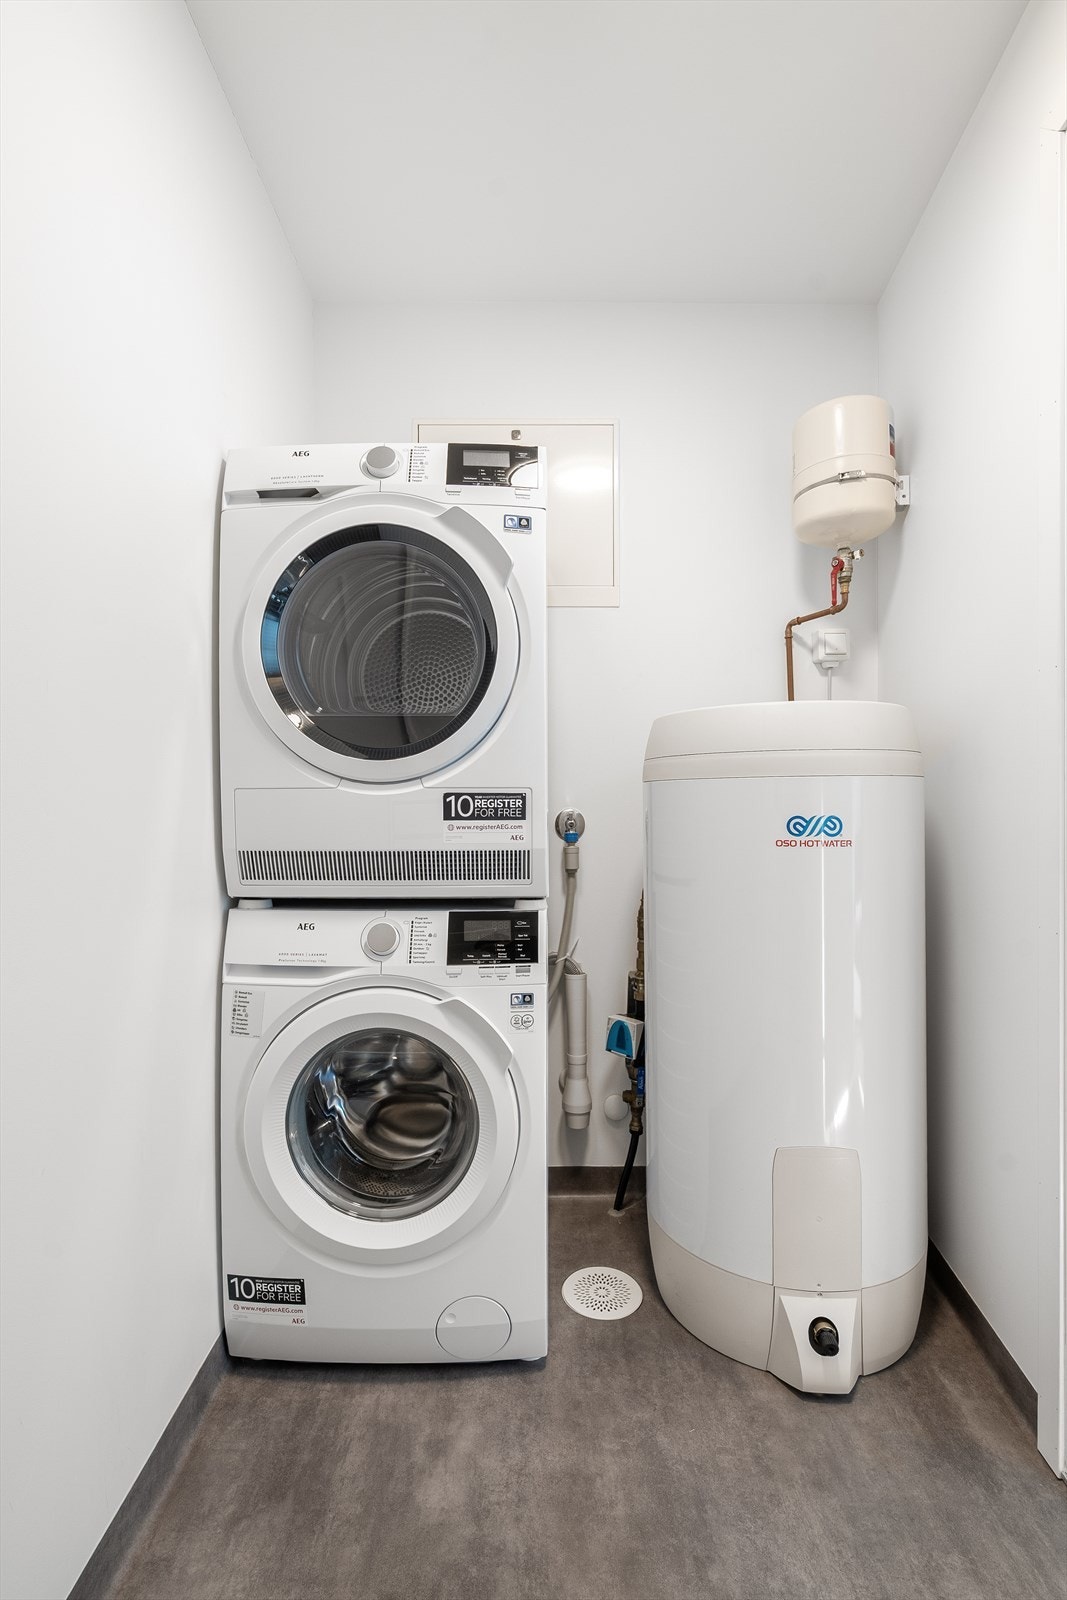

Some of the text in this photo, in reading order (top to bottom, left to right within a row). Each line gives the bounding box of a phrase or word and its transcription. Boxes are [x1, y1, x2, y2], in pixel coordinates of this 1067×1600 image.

[446, 795, 474, 817] 10
[474, 799, 523, 808] REGISTER
[474, 808, 522, 817] FOR FREE
[775, 839, 797, 847] OSO
[297, 923, 315, 931] AEG
[230, 1277, 256, 1299] 10
[256, 1282, 302, 1293] REGISTER
[256, 1291, 302, 1302] FOR FREE
[241, 1305, 304, 1313] www.registerAEG.com
